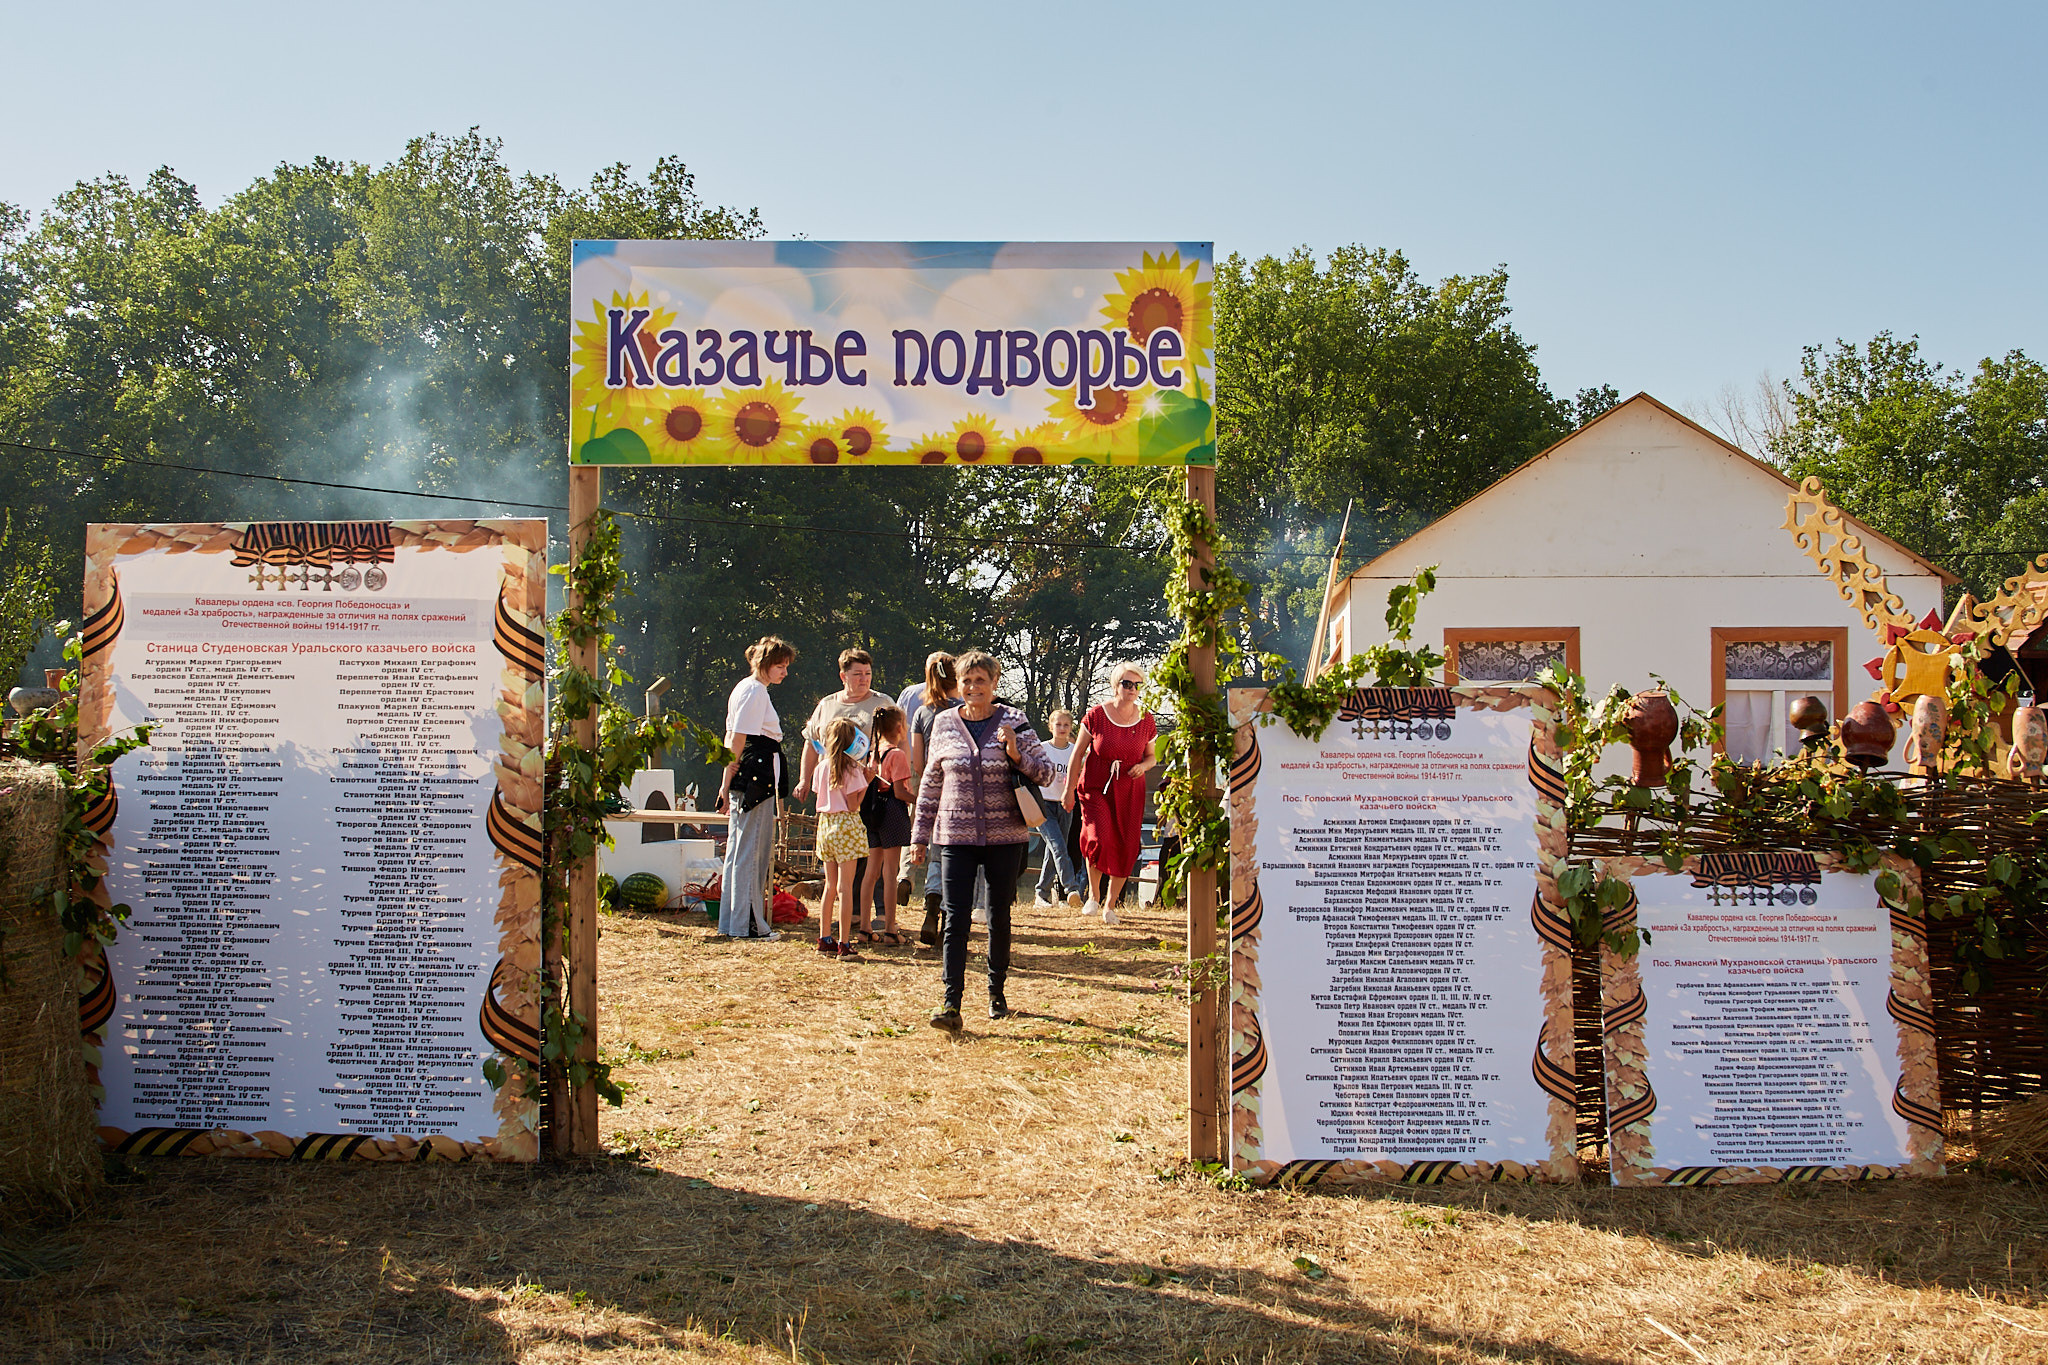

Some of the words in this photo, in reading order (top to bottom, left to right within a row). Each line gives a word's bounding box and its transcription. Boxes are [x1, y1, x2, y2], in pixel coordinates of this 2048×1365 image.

[607, 309, 867, 387] Казачье
[892, 329, 1183, 406] подворье
[195, 597, 239, 607] Кавалеры
[241, 599, 274, 608] ордена
[297, 599, 332, 609] Георгия
[335, 599, 401, 610] Победоносца»
[142, 607, 181, 616] медалей
[183, 608, 199, 616] «За
[257, 611, 324, 620] награжденные
[337, 612, 375, 620] отличия
[391, 613, 419, 621] полях
[421, 612, 465, 623] сражений
[221, 619, 289, 629] Отечественной
[292, 621, 322, 629] войны
[325, 621, 368, 630] 1914-1917
[146, 642, 197, 654] Станица
[201, 642, 287, 655] Студеновская
[291, 642, 362, 655] Уральского
[366, 644, 428, 653] казачьего
[431, 643, 475, 653] войска
[188, 659, 222, 667] Маркел
[225, 659, 281, 668] Григорьевич
[339, 659, 380, 667] Пастухов
[383, 659, 419, 668] Михаил
[420, 659, 476, 667] Евграфович
[131, 672, 186, 680] Березовсков
[392, 674, 416, 682] Иван
[417, 674, 478, 683] Евстафьевич
[198, 688, 221, 696] Иван
[223, 688, 270, 696] Викулович
[195, 702, 229, 711] Степан
[229, 702, 276, 711] Ефимович
[337, 703, 380, 711] Плакунов
[383, 702, 417, 711] Маркел
[1320, 750, 1355, 760] Кавалеры
[1356, 751, 1381, 760] ордена
[1398, 750, 1425, 760] Георгия
[1427, 751, 1477, 761] Победоносца»
[1280, 760, 1310, 770] медалей
[1311, 760, 1324, 769] «За
[1369, 762, 1419, 771] награжденные
[1491, 762, 1525, 772] сражений
[1341, 771, 1394, 780] Отечественной
[1396, 771, 1419, 779] войны
[1421, 771, 1453, 780] 1914-1917
[1282, 794, 1301, 802] Пос.
[1304, 794, 1351, 802] Головский
[1354, 794, 1420, 803] Мухрановской
[1461, 794, 1513, 803] Уральского
[149, 802, 177, 810] Жохов
[180, 803, 213, 811] Самсон
[215, 803, 268, 811] Николаевич
[1359, 802, 1403, 810] казачьего
[1405, 802, 1436, 810] войска
[1389, 818, 1430, 826] Епифанович
[1687, 913, 1719, 922] Кавалеры
[1720, 914, 1743, 922] ордена
[1758, 913, 1784, 922] Георгия
[1785, 913, 1831, 922] Победоносца»
[1651, 923, 1678, 932] медалей
[1679, 923, 1691, 931] «За
[1732, 925, 1779, 933] награжденные
[1845, 924, 1876, 934] сражений
[1325, 931, 1356, 940] Горбачев
[1358, 932, 1391, 940] Меркурий
[1393, 931, 1432, 940] Прохорович
[1434, 932, 1454, 940] орден
[1707, 933, 1756, 942] Отечественной
[1757, 934, 1779, 942] войны
[1780, 934, 1810, 942] 1914-1917
[1652, 959, 1672, 967] Пос.
[1674, 959, 1718, 967] Яманский
[1720, 958, 1784, 967] Мухрановской
[1826, 956, 1878, 966] Уральского
[1727, 966, 1771, 974] казачьего
[1773, 966, 1804, 974] войска
[338, 998, 370, 1007] Турчев
[373, 999, 407, 1008] Сергей
[408, 1000, 464, 1008] Маркелович
[1333, 1064, 1366, 1072] Ситников
[1368, 1064, 1385, 1072] Иван
[1387, 1064, 1428, 1073] Артемьевич
[1430, 1065, 1450, 1073] орден
[369, 1103, 412, 1113] Тимофей
[415, 1104, 464, 1112] Сидорович
